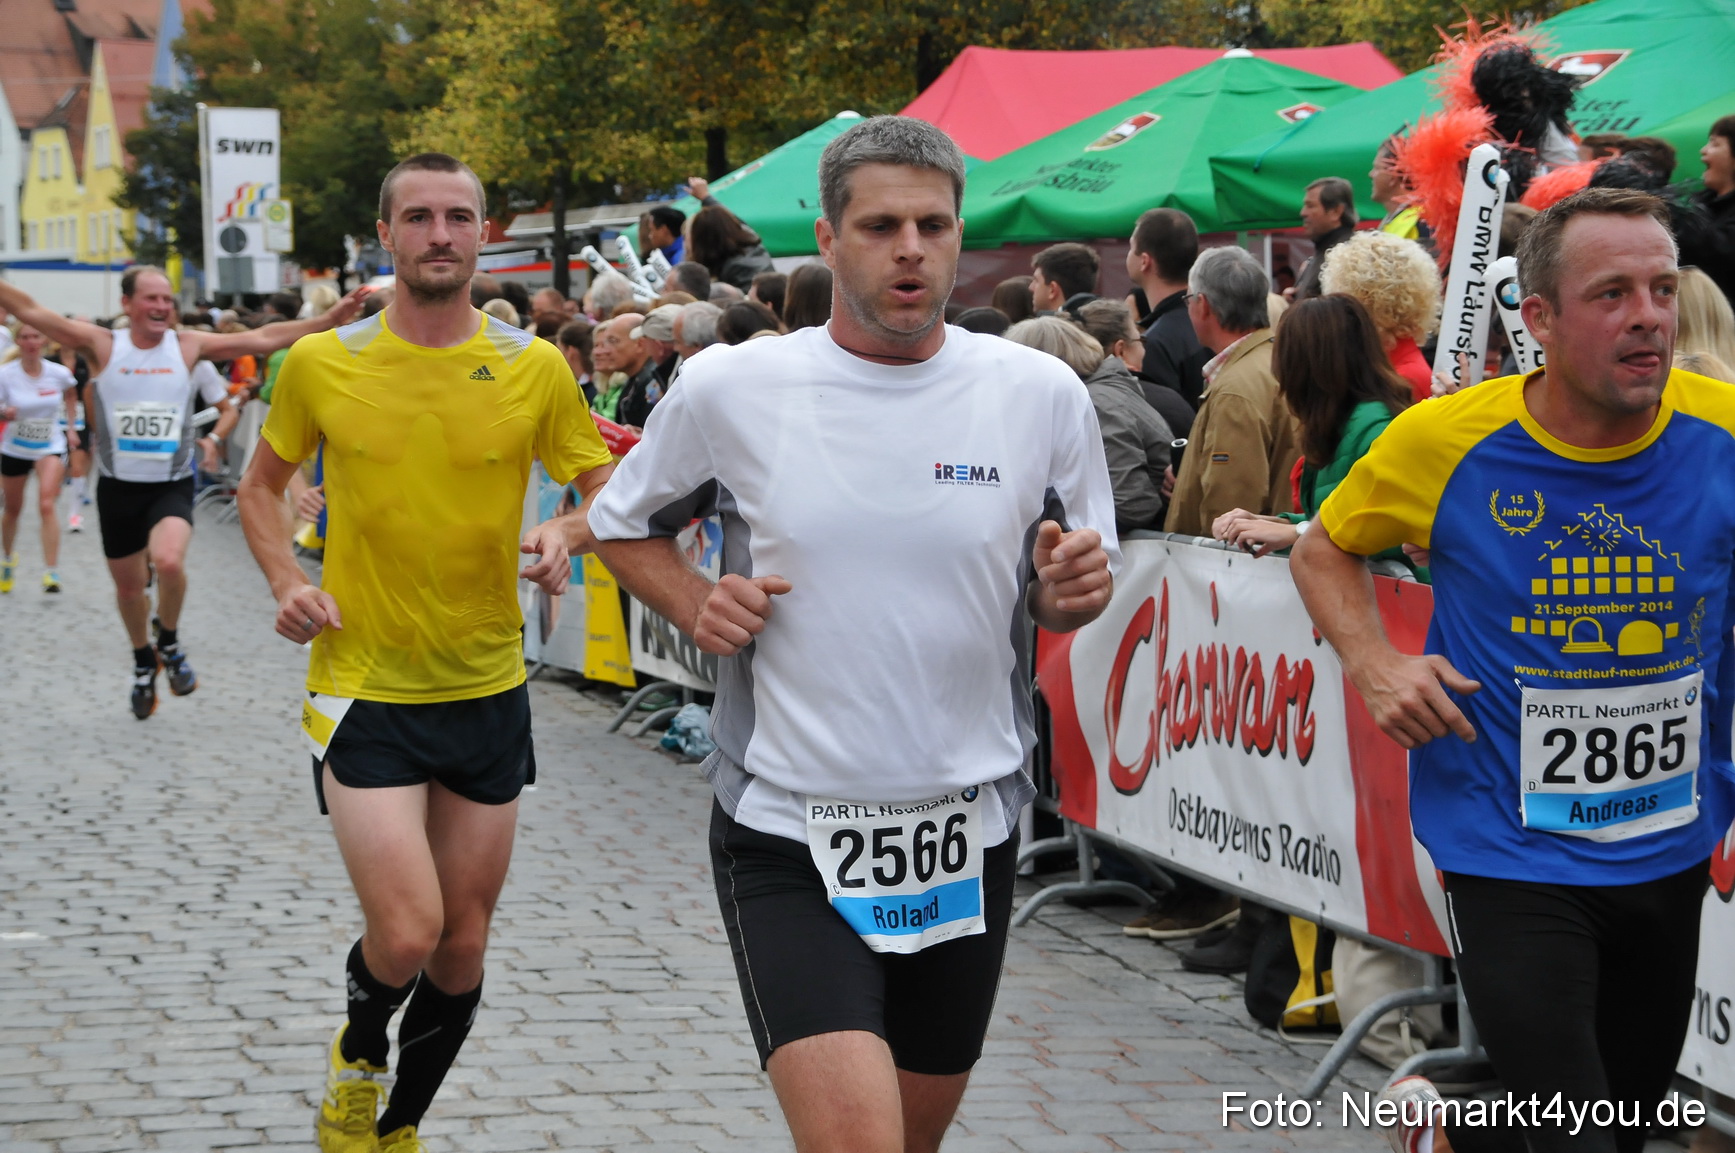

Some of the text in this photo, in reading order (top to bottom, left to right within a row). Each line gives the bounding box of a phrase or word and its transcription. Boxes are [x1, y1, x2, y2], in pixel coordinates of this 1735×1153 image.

[217, 138, 274, 155] swn
[469, 374, 496, 382] adidas
[121, 415, 174, 437] 2057
[934, 462, 1001, 483] iREMA
[1510, 494, 1524, 505] 15
[1501, 506, 1533, 518] Jahre
[1533, 600, 1674, 617] 21.September 2014
[1513, 655, 1696, 680] www.stadtlauf-neumarkt.de
[1104, 576, 1322, 796] Charivari
[1525, 697, 1680, 720] PARTL Neumarkt
[1542, 715, 1688, 785] 2865
[1528, 780, 1537, 792] D
[811, 804, 876, 820] PARTL
[1568, 793, 1660, 824] Andreas
[1168, 787, 1341, 887] Ostbayerns Radio
[829, 812, 968, 889] 2566
[832, 884, 840, 895] C
[872, 895, 940, 930] Roland
